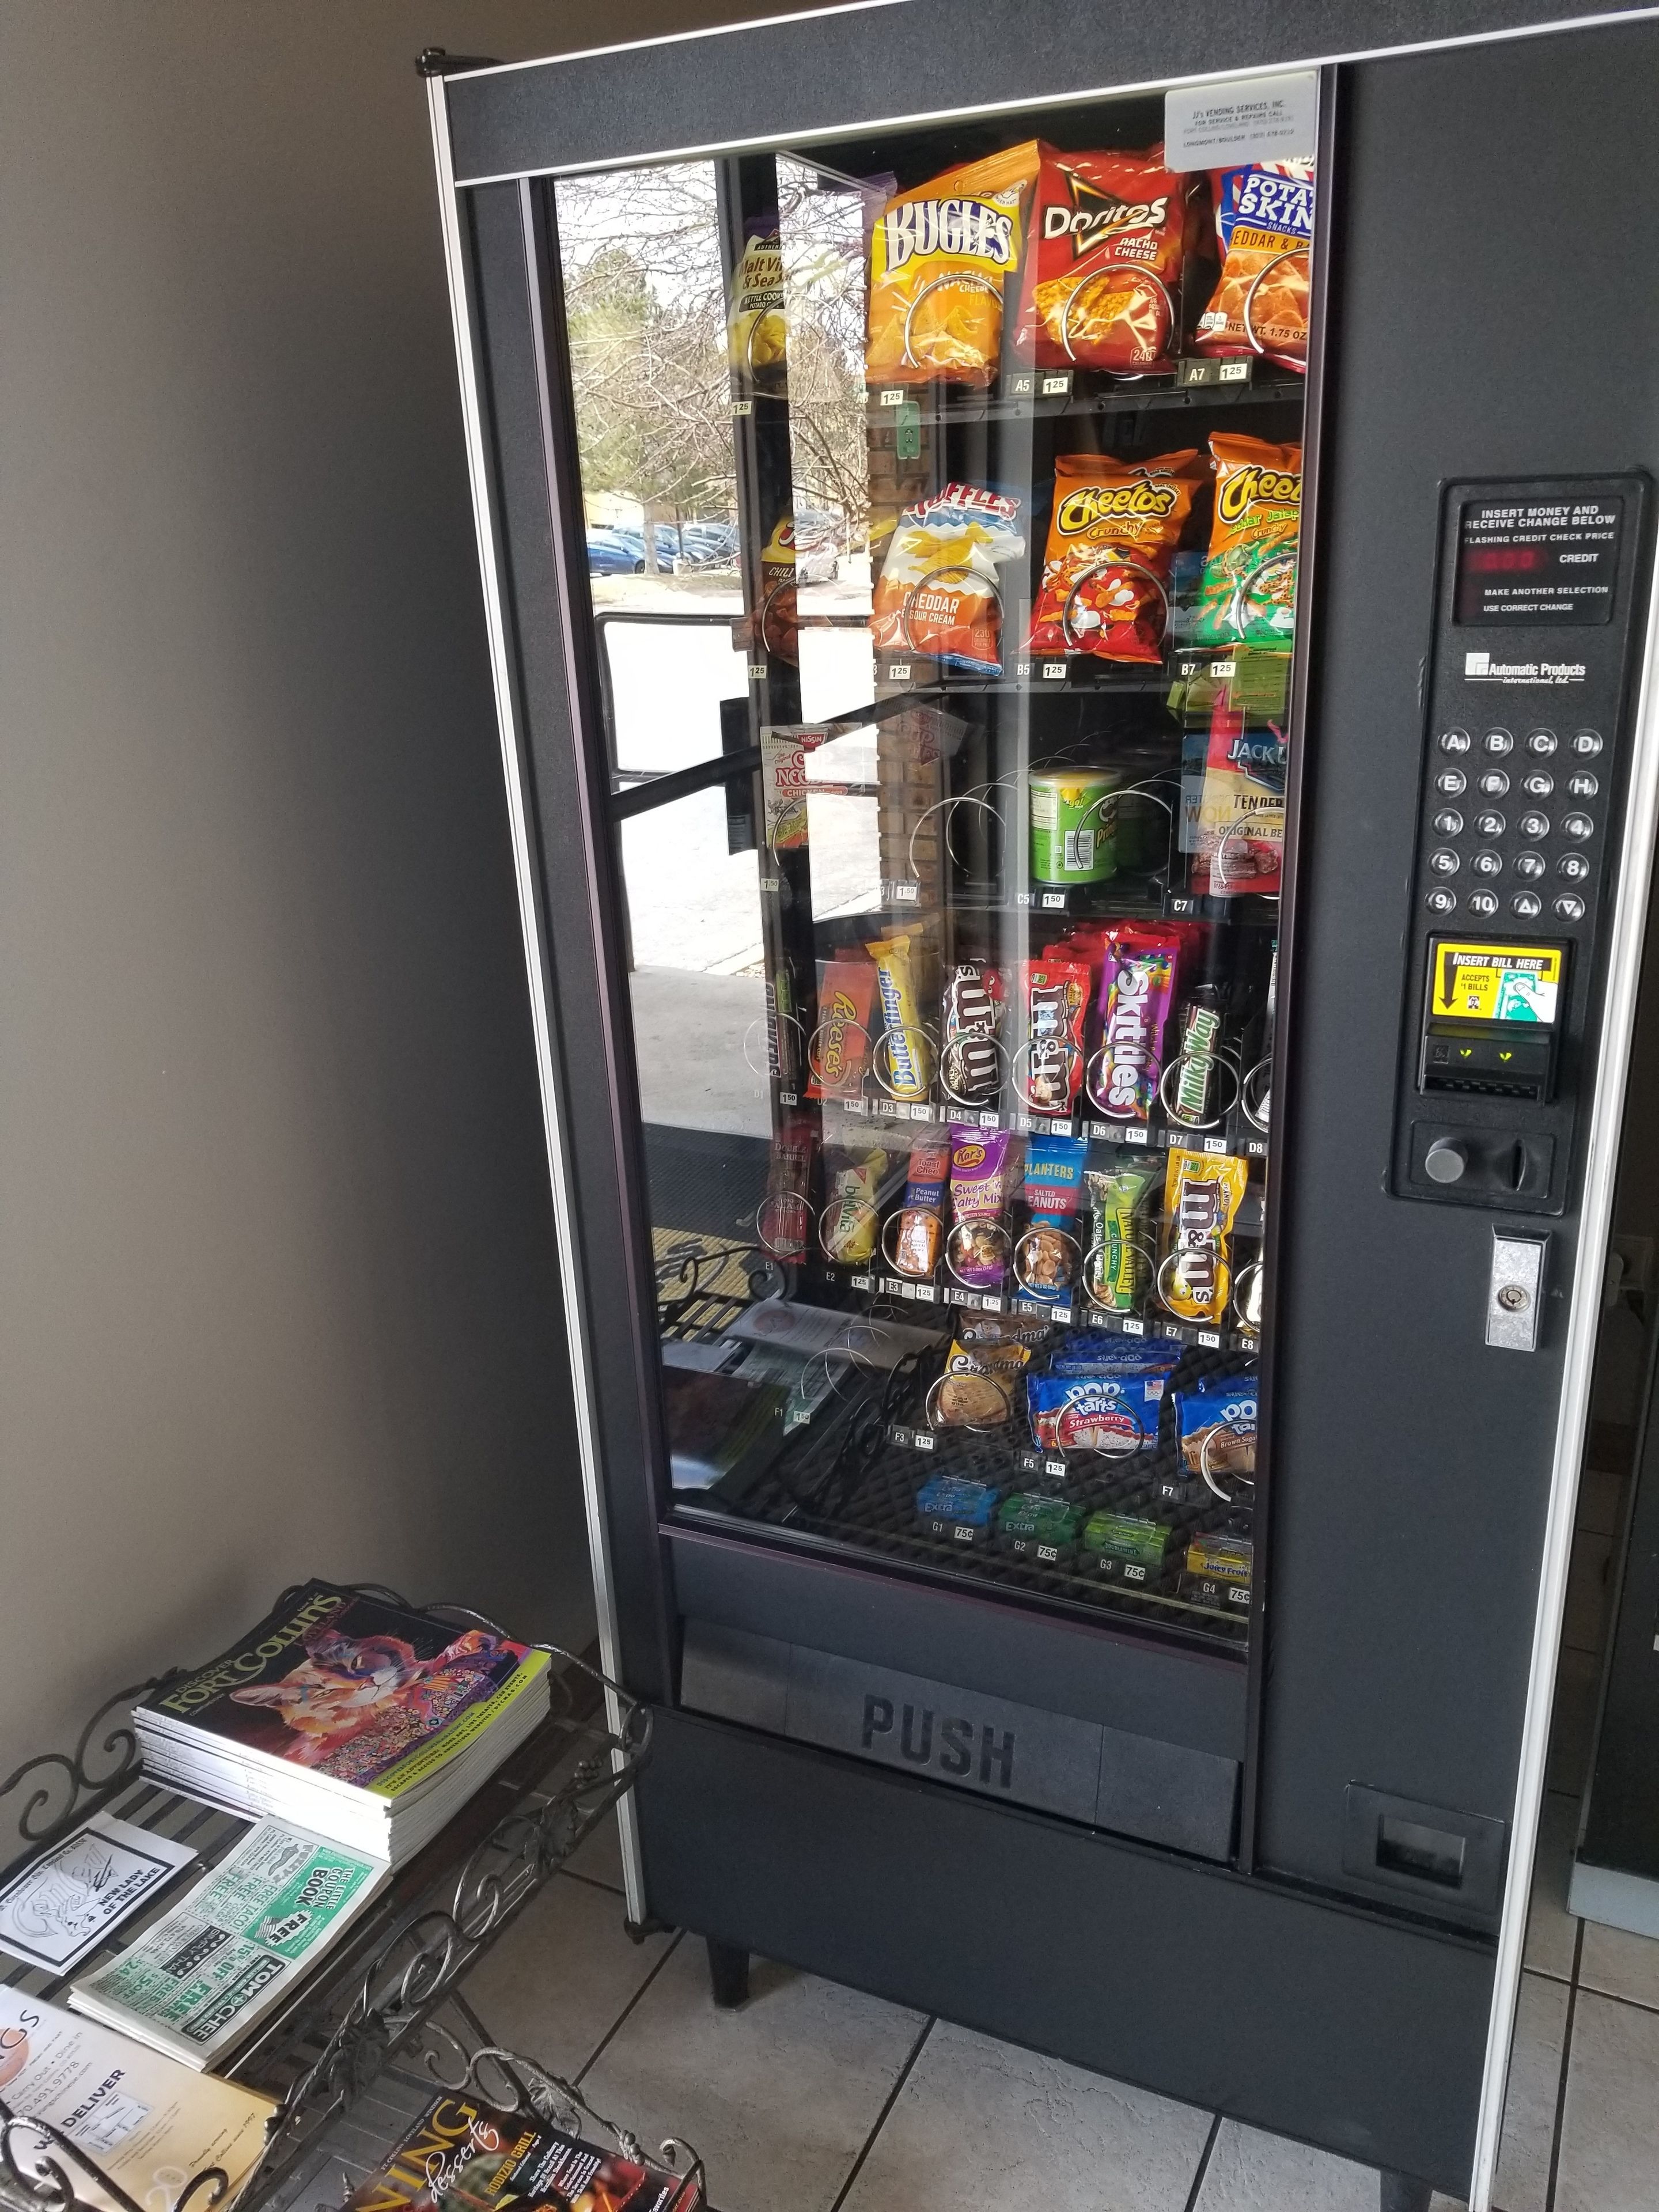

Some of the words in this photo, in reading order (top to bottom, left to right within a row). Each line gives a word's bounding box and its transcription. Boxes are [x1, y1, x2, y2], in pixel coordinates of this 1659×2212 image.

[1043, 196, 1169, 240] Doritos
[1267, 222, 1297, 234] SNACKS
[885, 199, 1013, 272] BUGLES
[1119, 237, 1158, 250] NACHO
[1115, 247, 1157, 260] CHEESE
[1270, 327, 1290, 338] 1.75
[1189, 368, 1205, 381] A7
[1016, 378, 1030, 392] A5
[1058, 482, 1177, 533] Cheetos
[1482, 507, 1524, 518] INSERT
[1528, 506, 1570, 517] MONEY
[1573, 505, 1599, 515] AND
[1465, 518, 1514, 529] RECEIVE
[1518, 517, 1567, 527] CHANGE
[1571, 514, 1616, 525] BELOW
[1087, 520, 1144, 540] Crunchy
[1252, 522, 1287, 539] Crunchy
[1464, 535, 1510, 544] FLASHING
[1513, 534, 1547, 542] CREDIT
[1550, 533, 1582, 541] CHECK
[1585, 531, 1615, 540] PRICE
[1559, 553, 1600, 563] CREDIT
[1484, 588, 1509, 596] MAKE
[1556, 586, 1609, 594] SELECTION
[903, 591, 960, 615] CHEDDAR
[1540, 603, 1574, 611] CHANGE
[909, 610, 927, 622] SOUR
[929, 612, 956, 626] CREAM
[1017, 663, 1030, 675] B5
[1181, 664, 1196, 676] B7
[1488, 663, 1539, 676] Automatic
[1540, 663, 1586, 676] Products
[801, 735, 823, 744] NISSIN
[1446, 734, 1462, 751] A
[1490, 735, 1504, 751] B
[1533, 735, 1550, 752] C
[1578, 736, 1594, 752] D
[1444, 775, 1457, 791] E
[1529, 777, 1546, 793] G
[1574, 778, 1589, 794] H
[1218, 826, 1267, 837] ORIGINAL
[1444, 816, 1452, 831] 1
[1484, 817, 1497, 832] 2
[1527, 818, 1539, 834] 3
[1570, 819, 1585, 835] 4
[1439, 855, 1451, 870] 5
[1480, 856, 1493, 872] 6
[1524, 858, 1536, 873] 7
[1567, 860, 1580, 876] 8
[1017, 893, 1030, 905] C5
[1435, 893, 1448, 909] 9
[1473, 896, 1494, 911] 10
[1174, 900, 1188, 911] C7
[1452, 952, 1491, 967] INSERT
[1491, 956, 1513, 968] BILL
[1516, 959, 1544, 970] HERE
[1461, 974, 1490, 983] ACCEPTS
[1468, 983, 1488, 991] BILLS
[878, 967, 918, 1086] Butterfinger
[824, 991, 858, 1078] Reese's
[1108, 969, 1150, 1107] Skittles
[882, 1103, 893, 1113] D3
[950, 1111, 961, 1121] D4
[1020, 1118, 1032, 1128] D5
[1093, 1127, 1105, 1137] D6
[1169, 1134, 1183, 1146] D7
[775, 1142, 807, 1153] DOUBLE
[1249, 1143, 1263, 1153] D8
[776, 1152, 806, 1162] BARREL
[957, 1148, 983, 1164] Kar's
[918, 1158, 941, 1168] Toast
[916, 1165, 938, 1175] Chee
[1025, 1162, 1074, 1180] PLANTERS
[916, 1187, 940, 1197] Peanut
[953, 1183, 990, 1197] Sweet
[1034, 1189, 1056, 1198] SALTED
[1222, 1181, 1232, 1207] PEANUT
[915, 1194, 936, 1203] Butter
[983, 1192, 1002, 1205] Mix
[826, 1271, 835, 1282] E2
[1122, 1252, 1135, 1290] VALLEY
[889, 1281, 899, 1291] E3
[955, 1291, 964, 1301] E4
[1022, 1302, 1032, 1312] E5
[1092, 1315, 1103, 1325] E6
[1165, 1327, 1177, 1338] E7
[1241, 1339, 1254, 1350] E8
[1069, 1415, 1125, 1429] Strawberry
[895, 1432, 905, 1442] F3
[1220, 1438, 1241, 1449] Brown
[1024, 1459, 1034, 1468] F5
[1162, 1486, 1173, 1497] F7
[925, 1502, 953, 1513] Extra
[932, 1521, 943, 1532] G1
[1005, 1521, 1035, 1532] Extra
[1014, 1540, 1026, 1551] G2
[1100, 1559, 1112, 1570] G3
[1203, 1582, 1215, 1594] G4
[175, 1659, 234, 1694] DISCOVER
[861, 1694, 1015, 1789] PUSH
[342, 1868, 354, 1884] THE
[99, 1887, 121, 1906] NEW
[119, 1869, 145, 1889] LADY
[103, 1902, 118, 1915] OF
[115, 1887, 137, 1905] THE
[136, 1868, 161, 1889] LAKE
[210, 1873, 241, 1900] FREE
[296, 1868, 328, 1907] BOOK
[313, 1867, 339, 1909] COUPON
[325, 1885, 345, 1910] LITTLE
[268, 1913, 307, 1944] FREE
[60, 2069, 127, 2128] DELIVER
[484, 2159, 517, 2197] RODIZIO
[510, 2130, 537, 2159] GRILL
